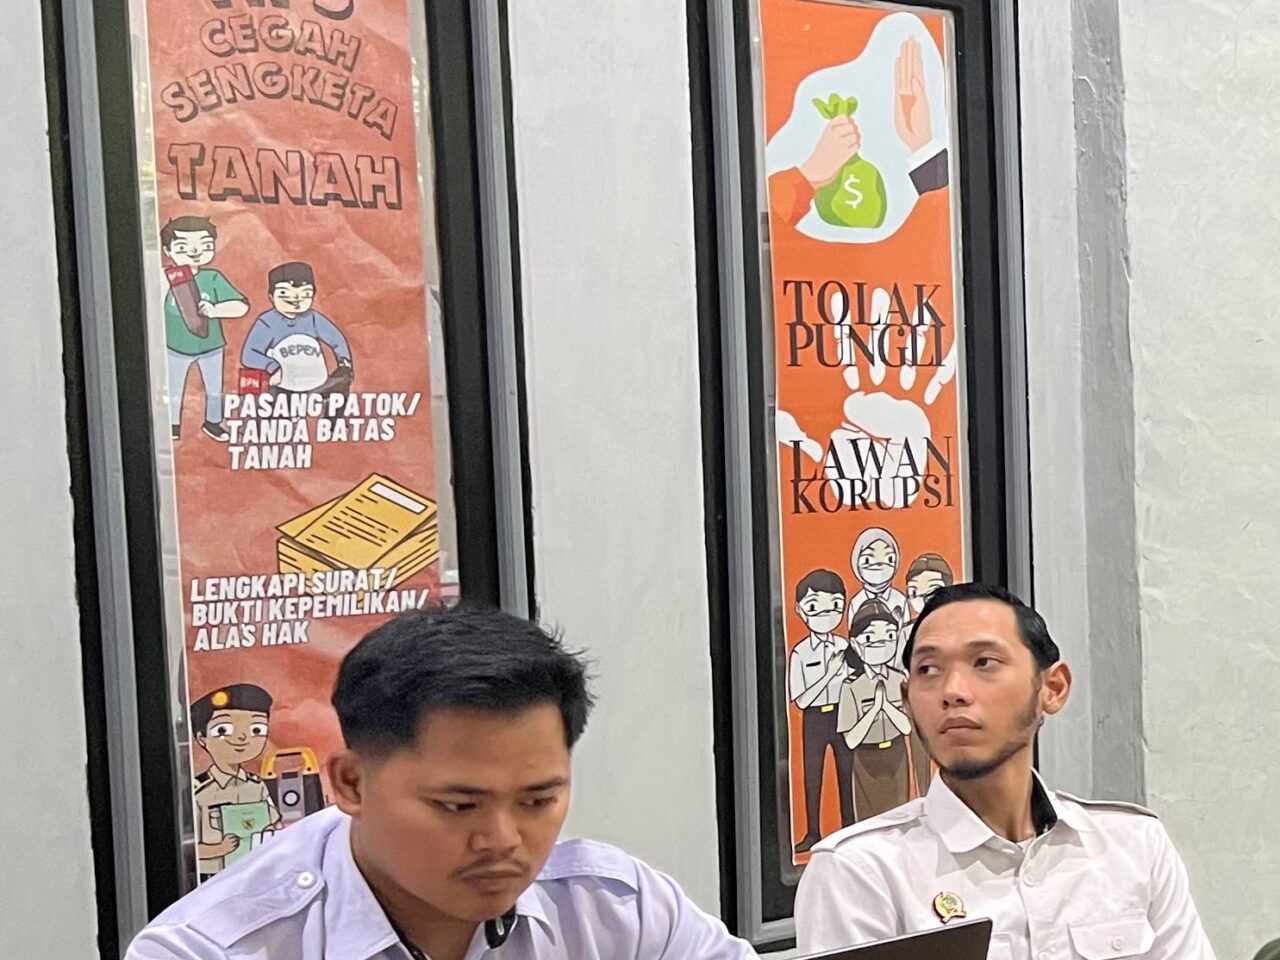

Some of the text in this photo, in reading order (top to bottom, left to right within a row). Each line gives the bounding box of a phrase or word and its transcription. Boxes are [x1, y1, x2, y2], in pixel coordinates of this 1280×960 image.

[200, 15, 362, 72] CEGAH
[160, 61, 401, 141] SENGKETA
[168, 142, 402, 210] TANAH
[783, 280, 946, 327] TOLAK
[786, 322, 946, 367] PUNGLI
[224, 392, 420, 418] PASANG PATOK/
[226, 417, 395, 442] TANDA BATAS
[228, 445, 312, 470] TANAH
[789, 436, 952, 480] LAWAN
[791, 474, 955, 514] KORUPSI
[191, 569, 396, 602] LENGKAPI SURAT/
[192, 589, 429, 627] BUKTI KEPEMILIKAN/
[193, 621, 310, 652] ALAS HAK
